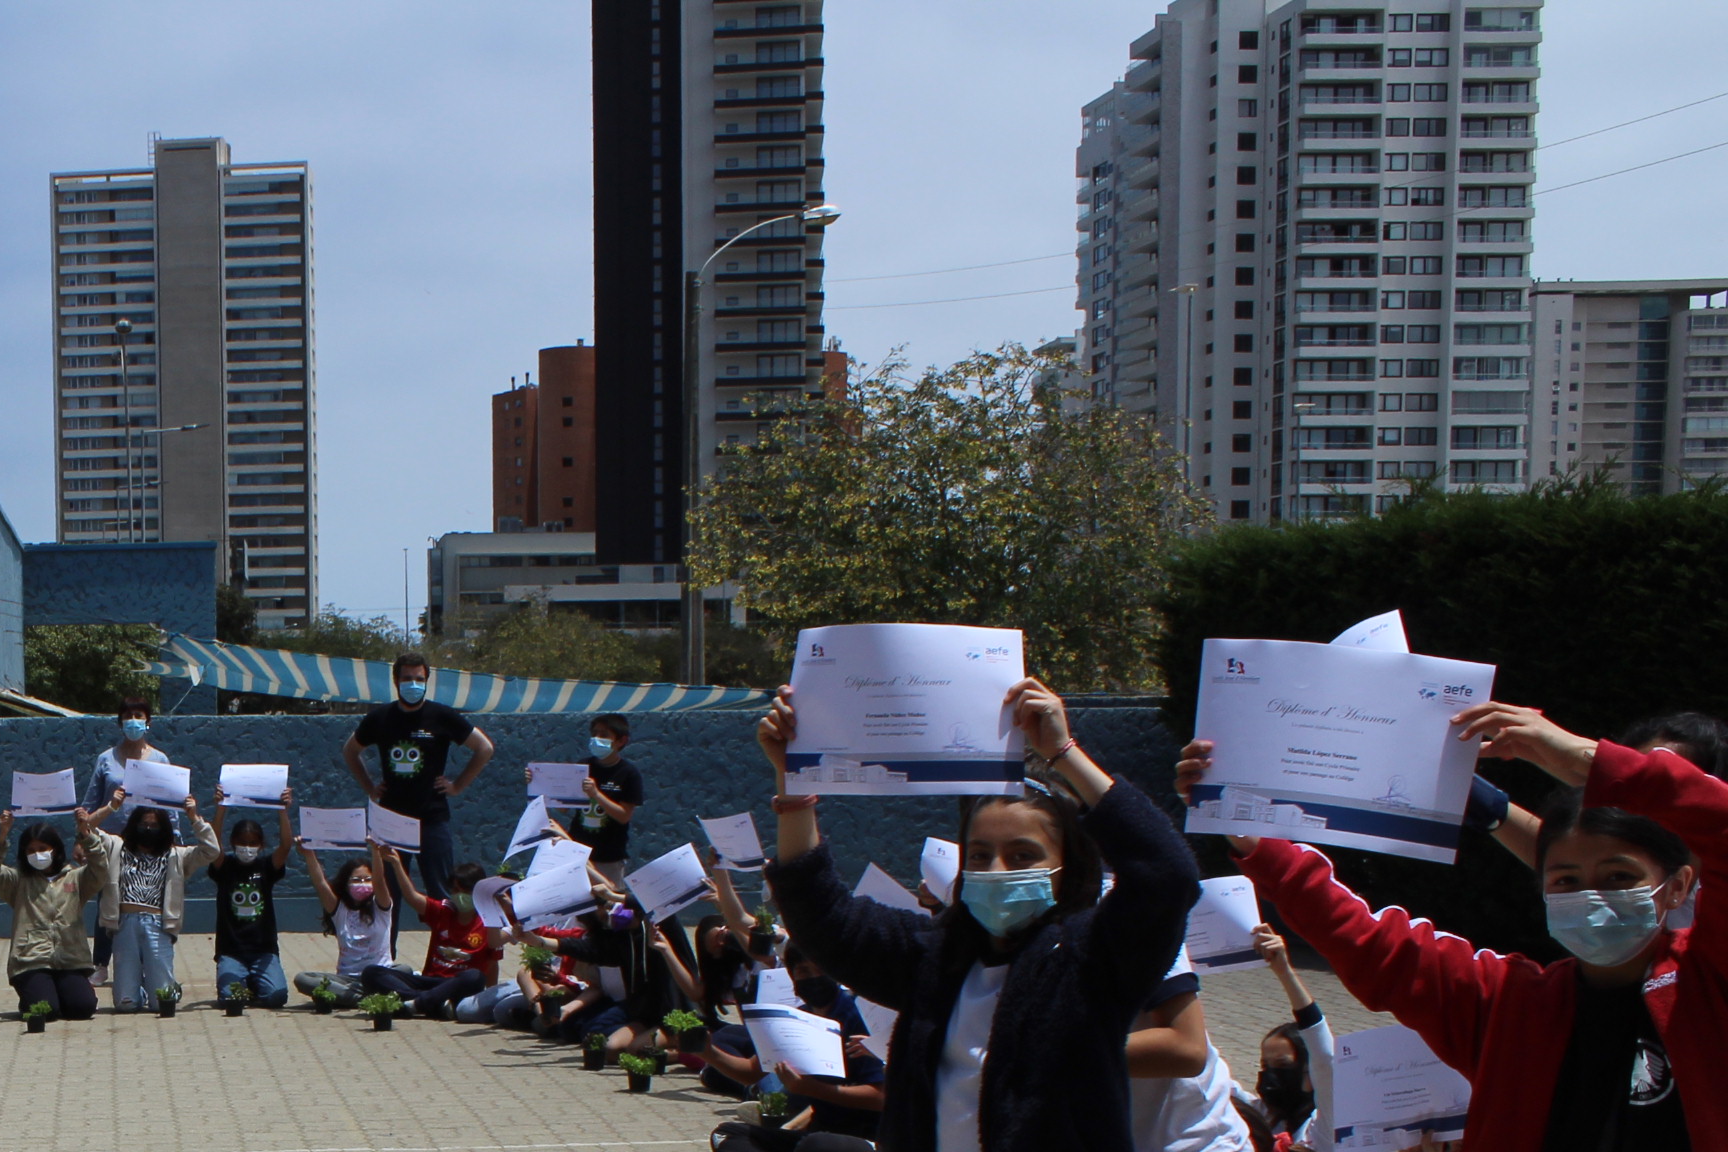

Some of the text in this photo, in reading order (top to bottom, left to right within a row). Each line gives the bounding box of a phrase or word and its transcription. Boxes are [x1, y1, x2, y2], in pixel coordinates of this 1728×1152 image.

[985, 647, 1009, 656] aefe
[1443, 684, 1473, 697] aefe
[1337, 705, 1397, 725] Honneur
